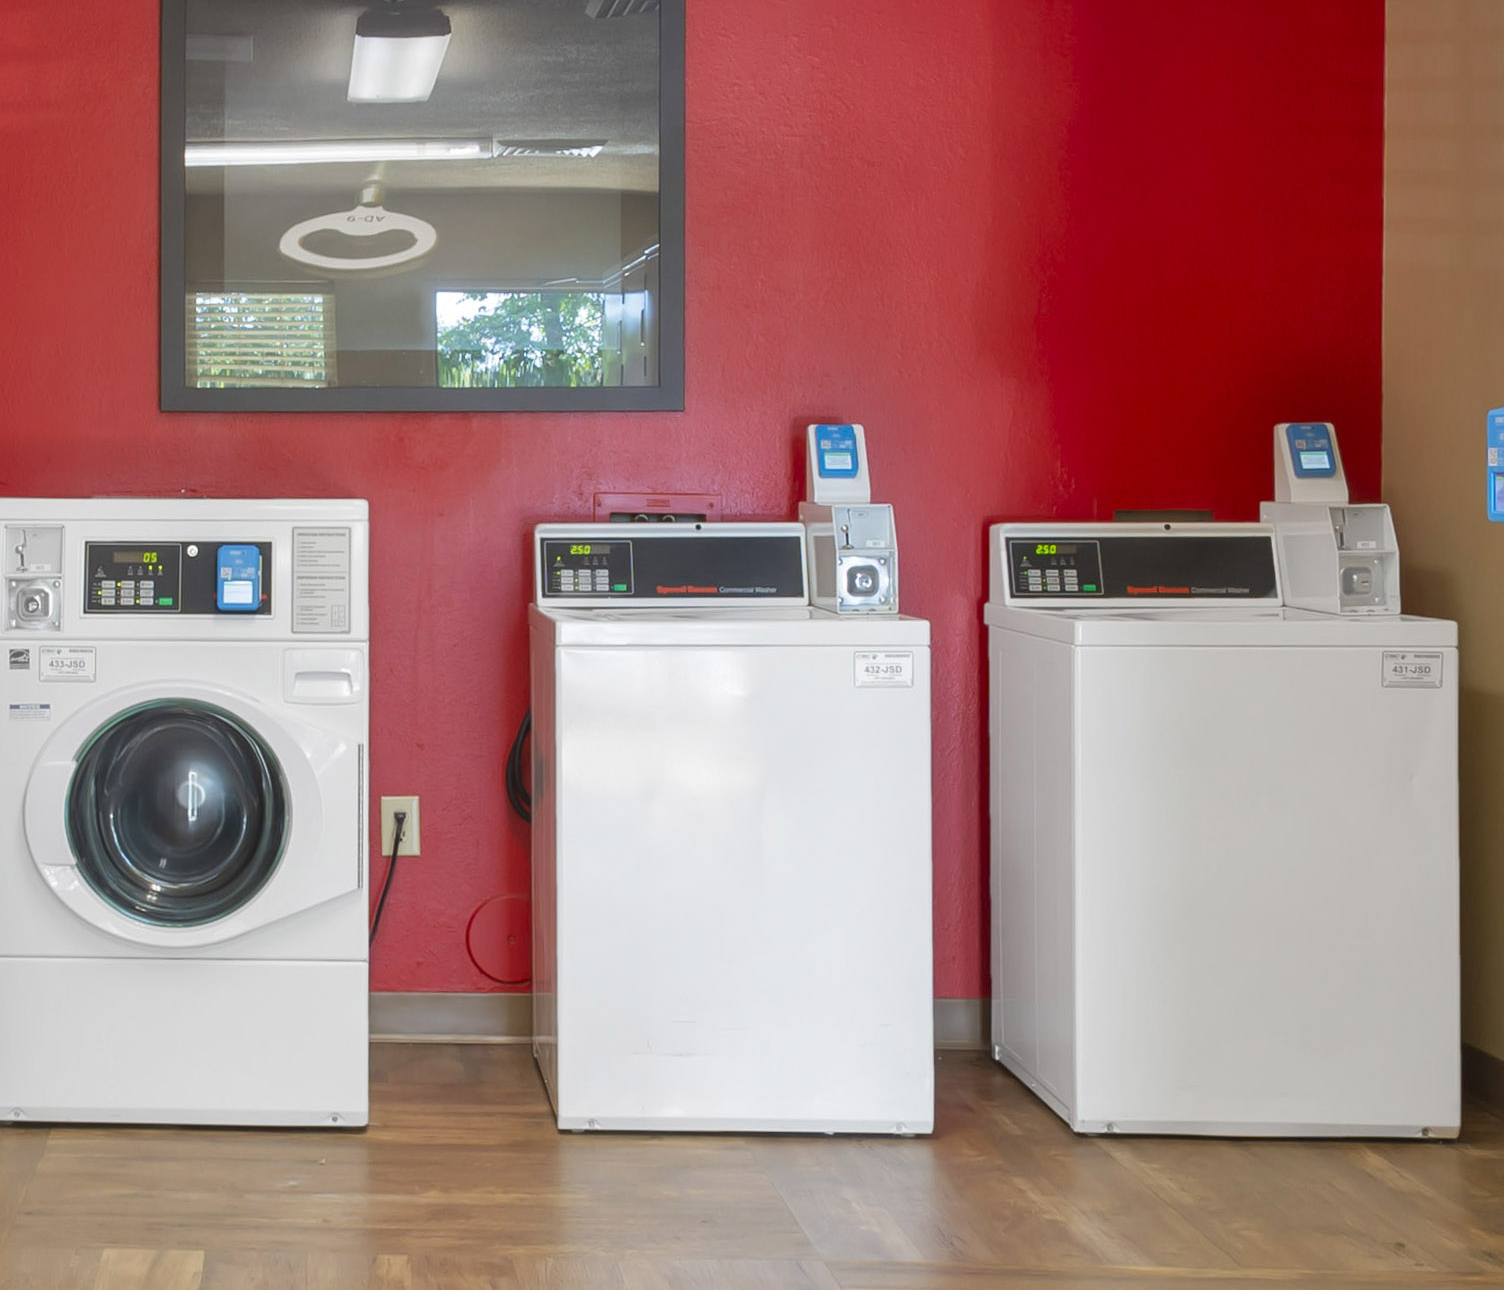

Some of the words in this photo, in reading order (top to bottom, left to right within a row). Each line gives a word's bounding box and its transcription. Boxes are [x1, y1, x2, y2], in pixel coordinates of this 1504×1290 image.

[48, 659, 86, 670] 433-JSD
[863, 664, 903, 676] 432-JSD
[1392, 664, 1432, 676] 431-JSD
